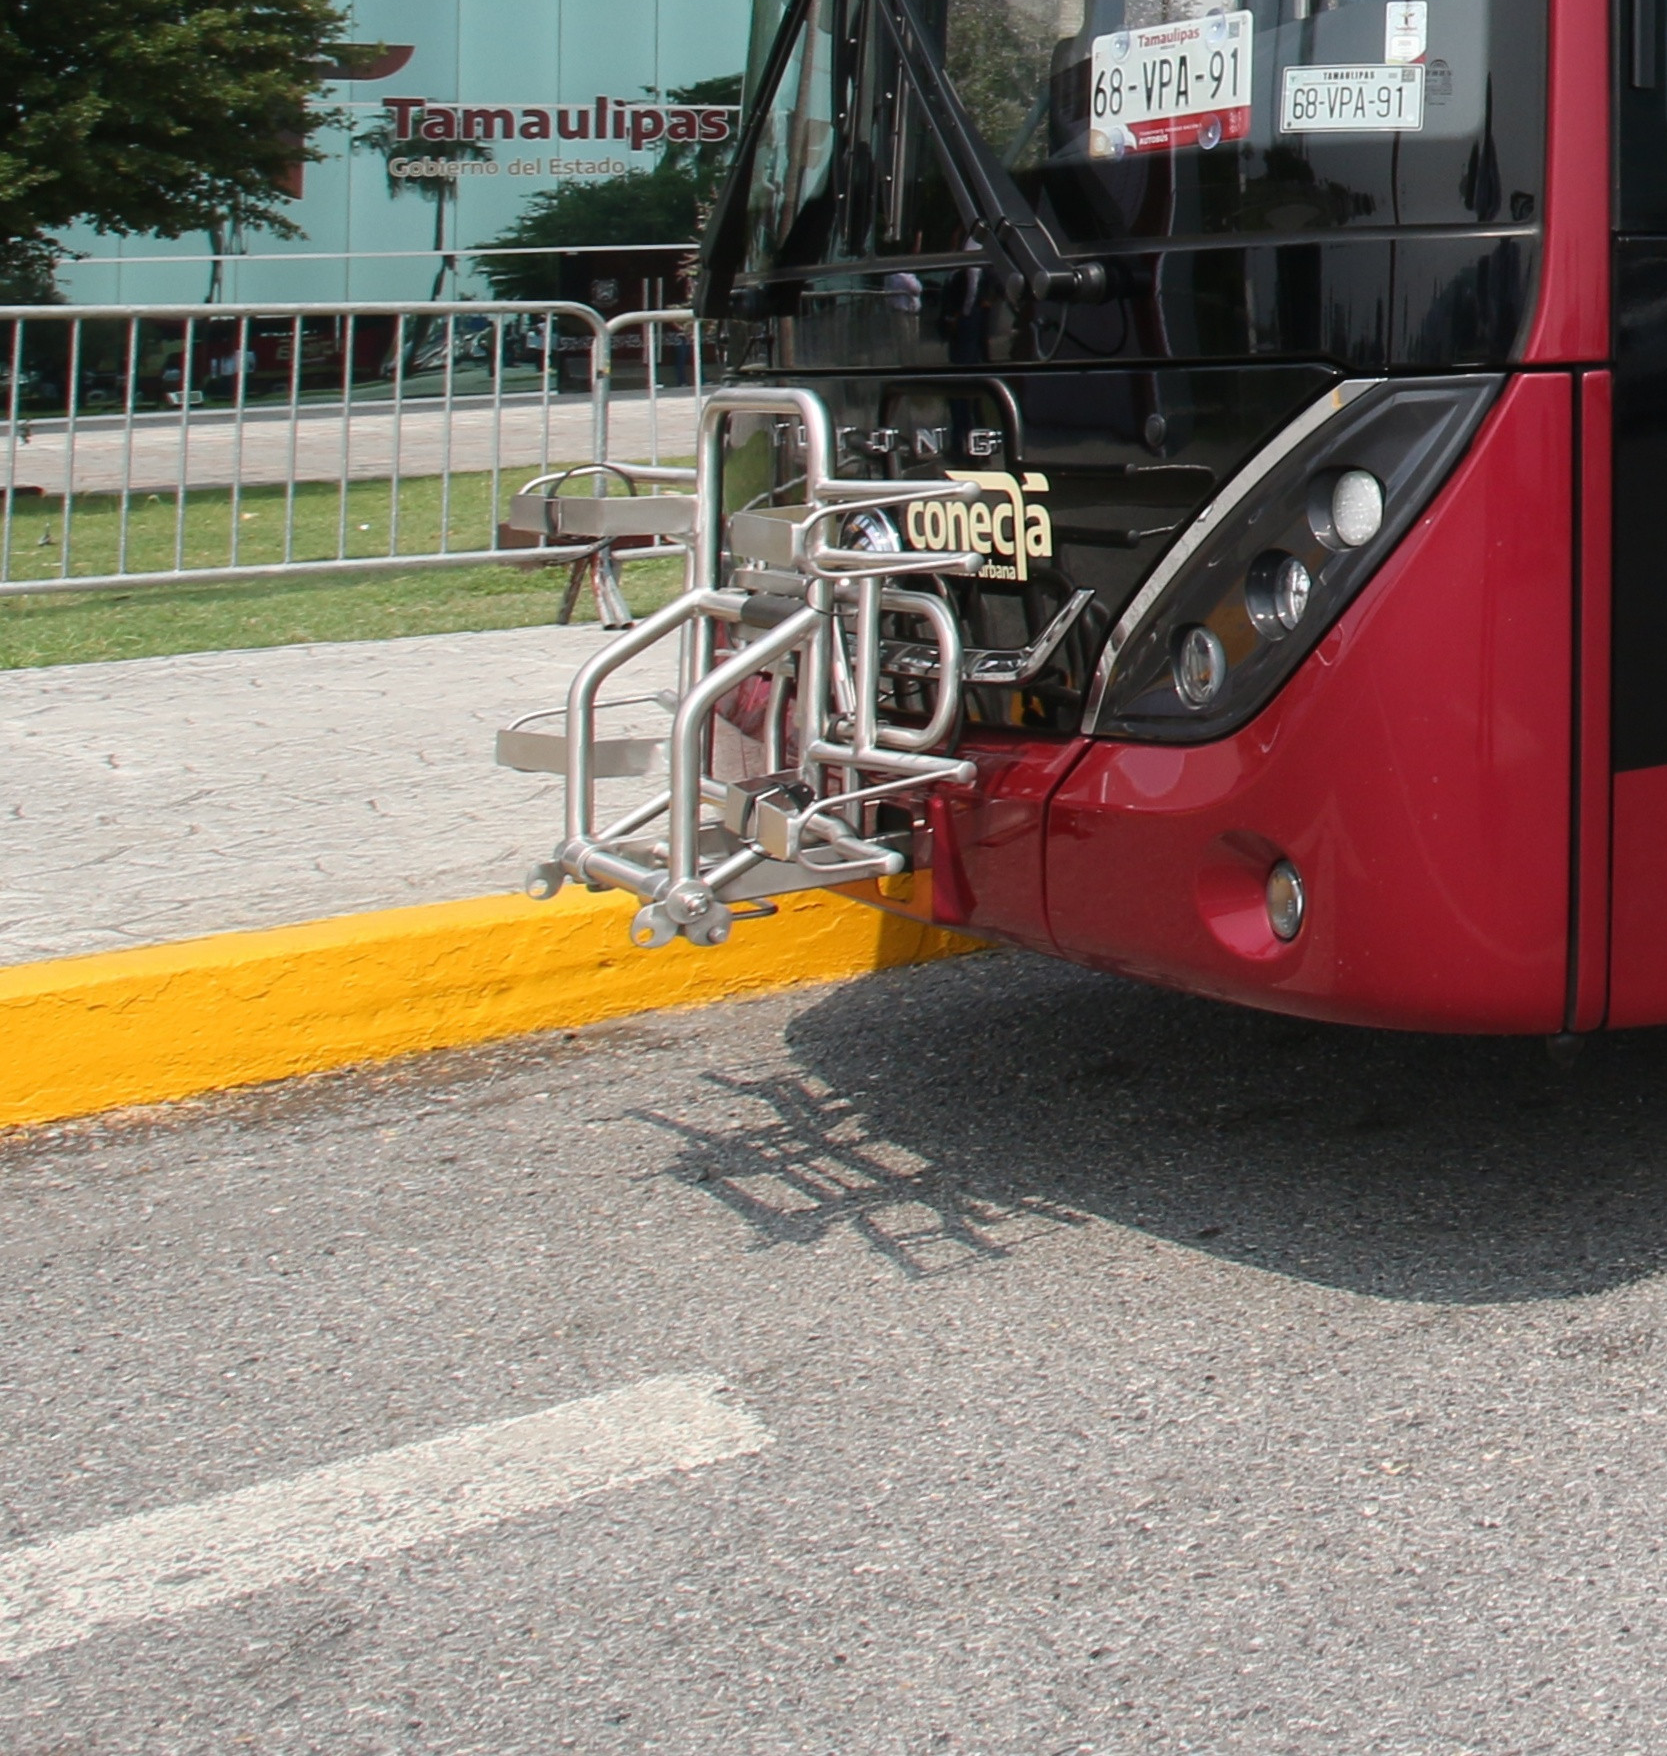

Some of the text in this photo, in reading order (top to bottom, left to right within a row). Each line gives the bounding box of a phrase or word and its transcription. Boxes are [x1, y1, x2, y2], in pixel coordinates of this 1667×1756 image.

[1137, 26, 1200, 48] Tamaulipas
[1094, 47, 1239, 118] 68-VPA-91
[1323, 71, 1376, 80] TAMAULIPAS
[1292, 85, 1404, 120] 68-VPA-91
[382, 95, 730, 152] Tamaulipas
[388, 156, 627, 178] Gobierno del Estado
[906, 469, 1053, 581] conecta
